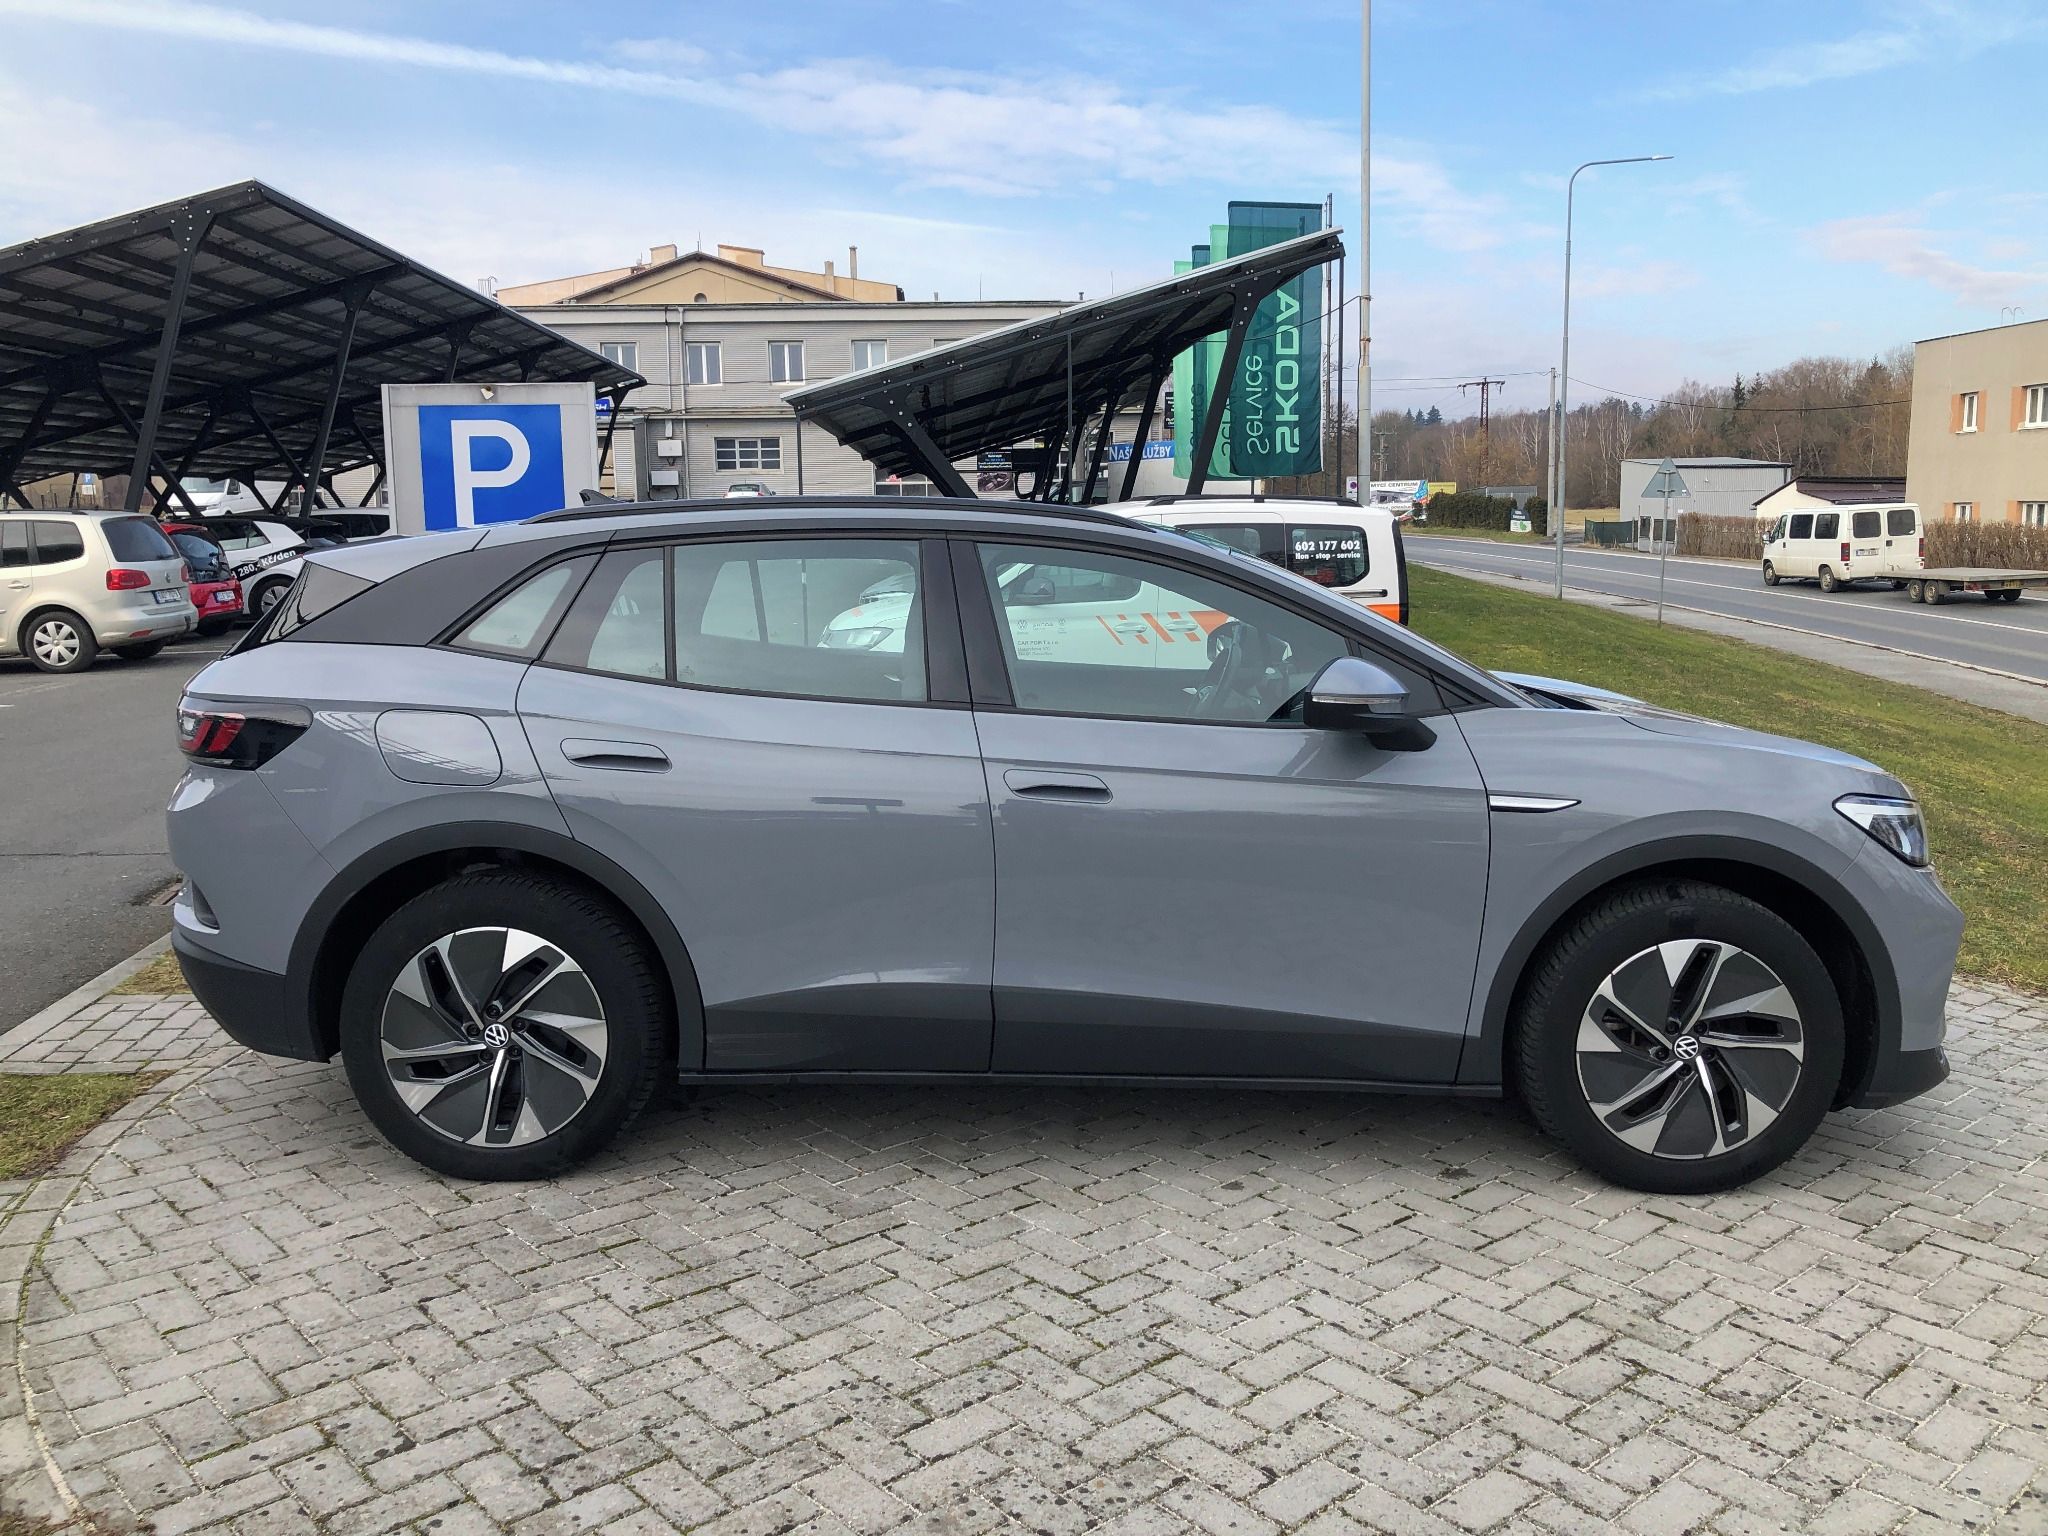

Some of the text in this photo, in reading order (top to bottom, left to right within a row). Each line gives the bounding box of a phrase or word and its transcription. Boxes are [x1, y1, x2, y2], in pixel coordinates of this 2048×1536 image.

[1109, 444, 1172, 461] NAŠ LUŽBY
[450, 419, 531, 529] P
[1295, 540, 1361, 551] 602 177 602
[261, 550, 296, 567] Kč/den
[1315, 552, 1331, 560] stop
[1336, 551, 1361, 559] service
